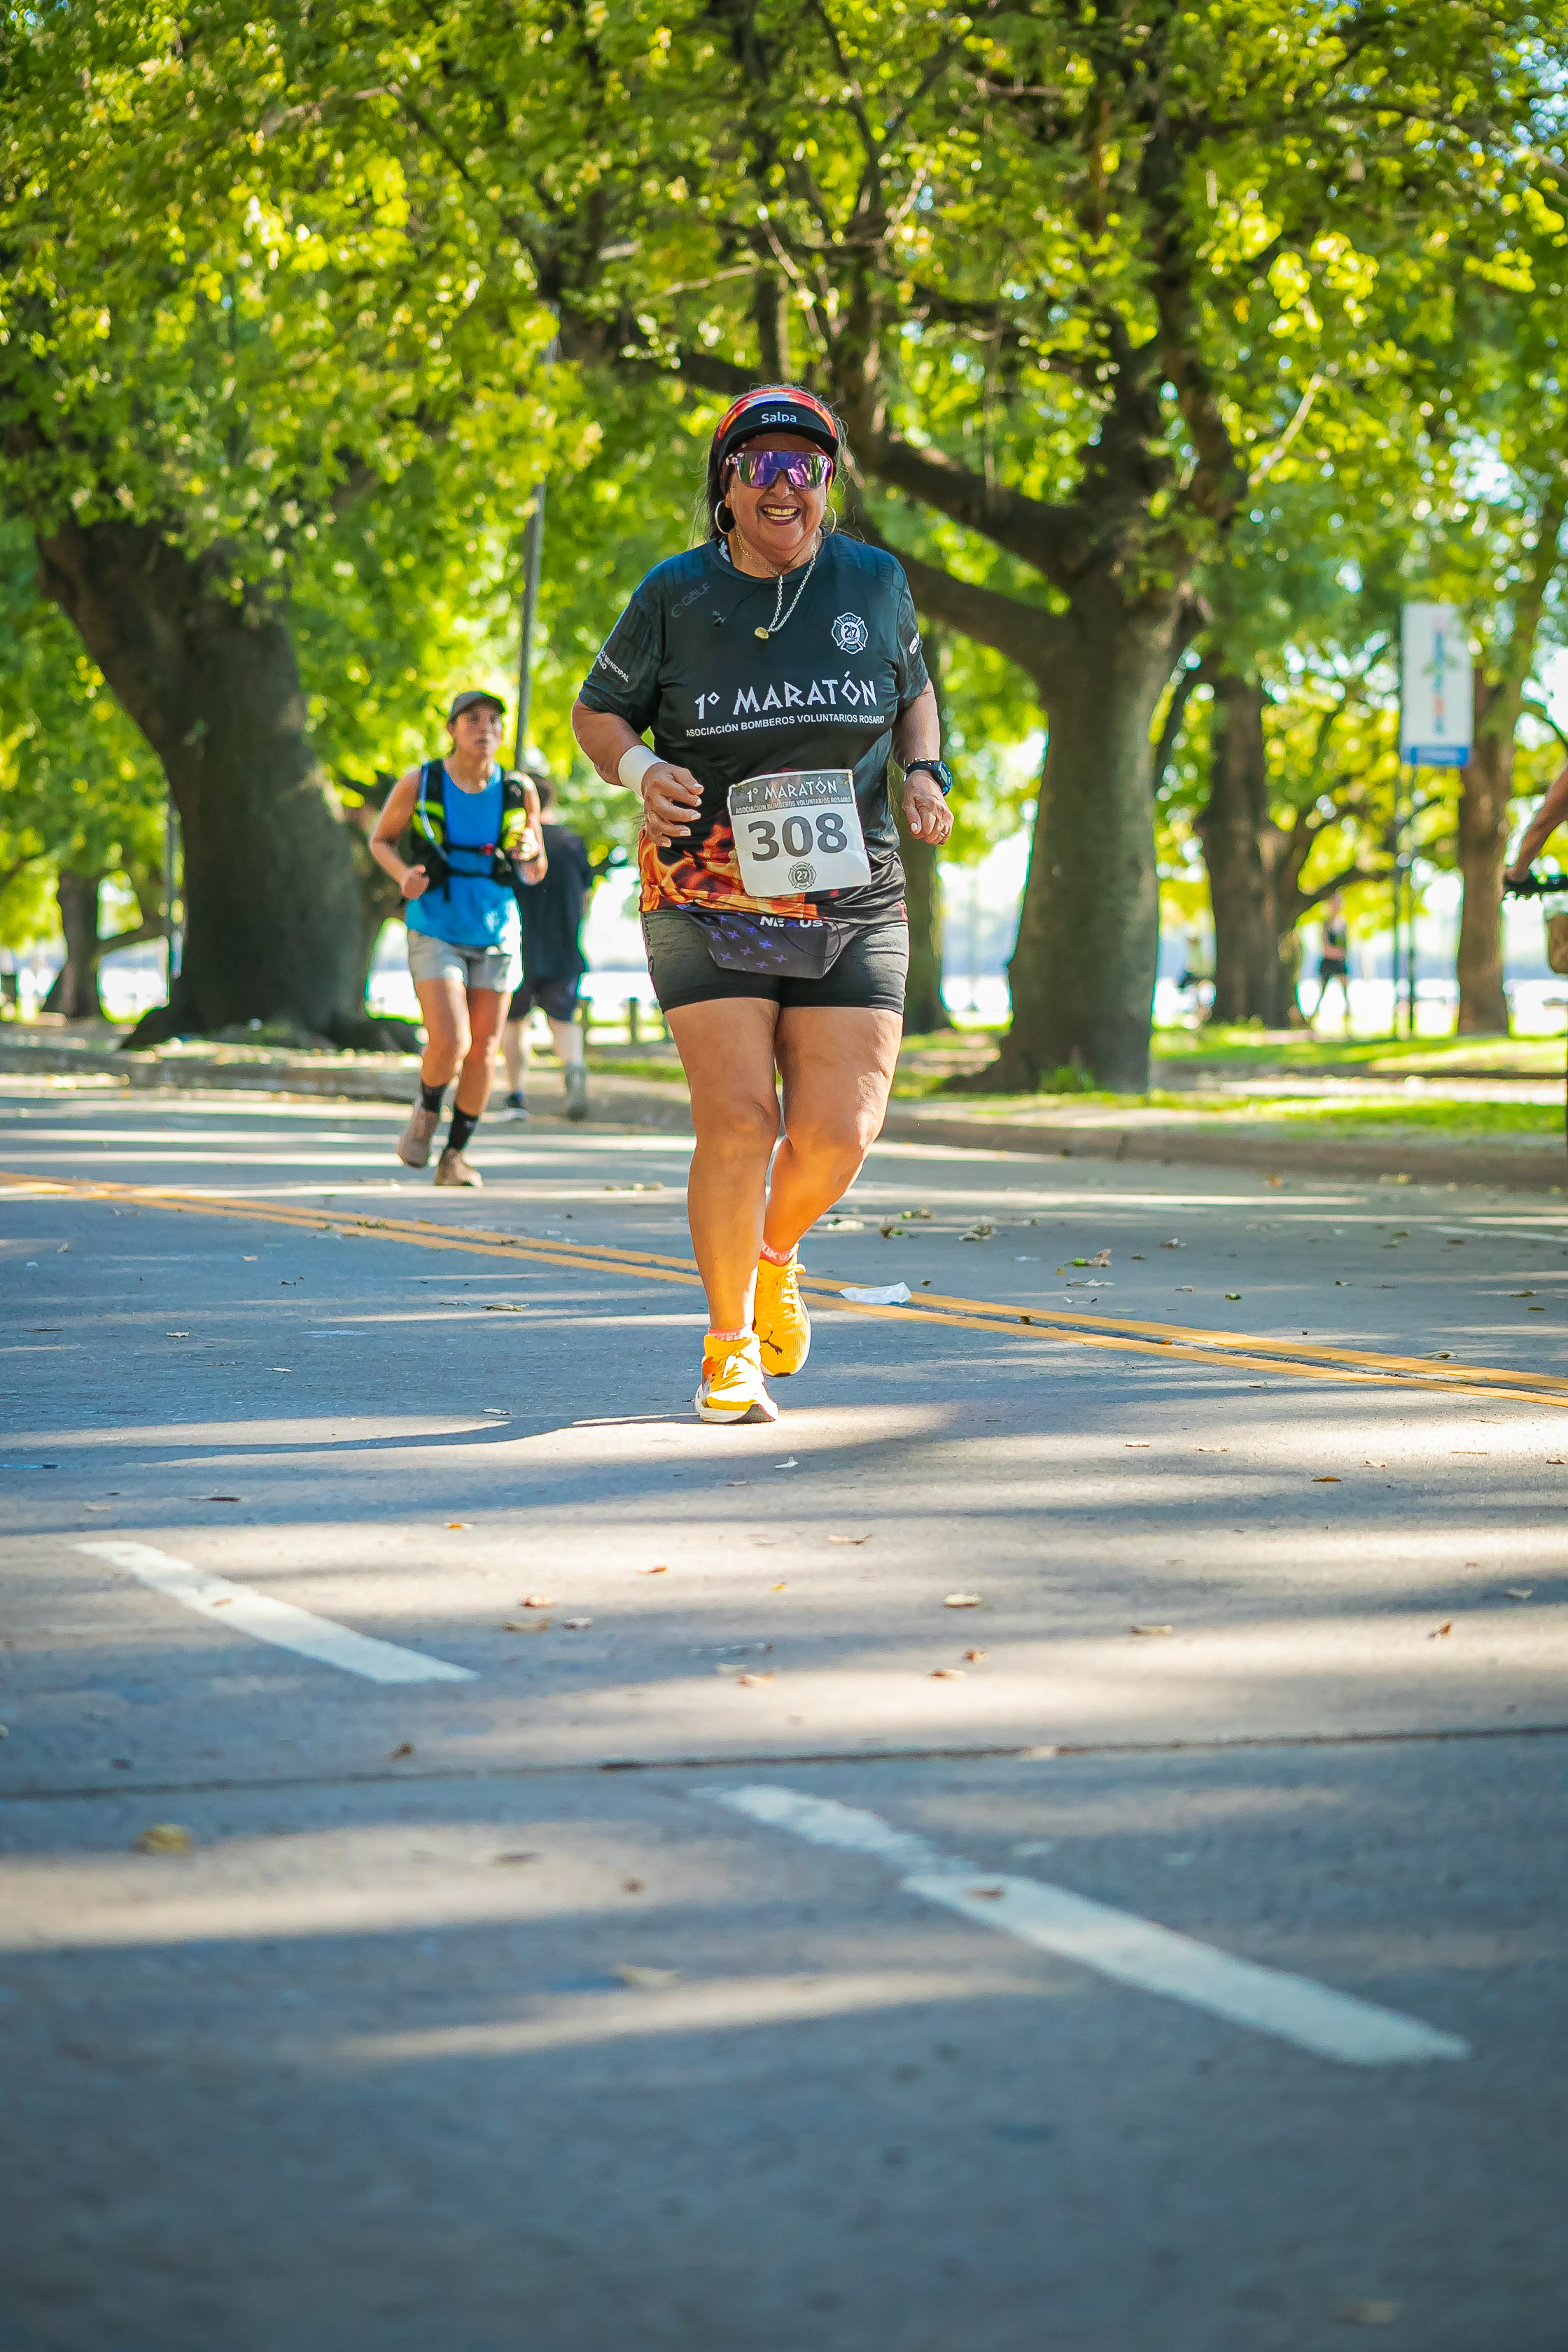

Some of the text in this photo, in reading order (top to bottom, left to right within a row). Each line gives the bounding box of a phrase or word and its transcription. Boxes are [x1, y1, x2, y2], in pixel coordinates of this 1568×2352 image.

[761, 411, 797, 424] Salpa
[732, 671, 877, 715] MARATÓN
[686, 713, 885, 737] ASOCIACIÓN BOMBEROS VOLUNTARIOS ROSARIO
[764, 776, 838, 801] MARATÓN
[797, 797, 830, 806] VOLUNTARIOS
[830, 795, 851, 804] ROSARIO
[748, 813, 848, 861] 308
[797, 871, 808, 881] 27
